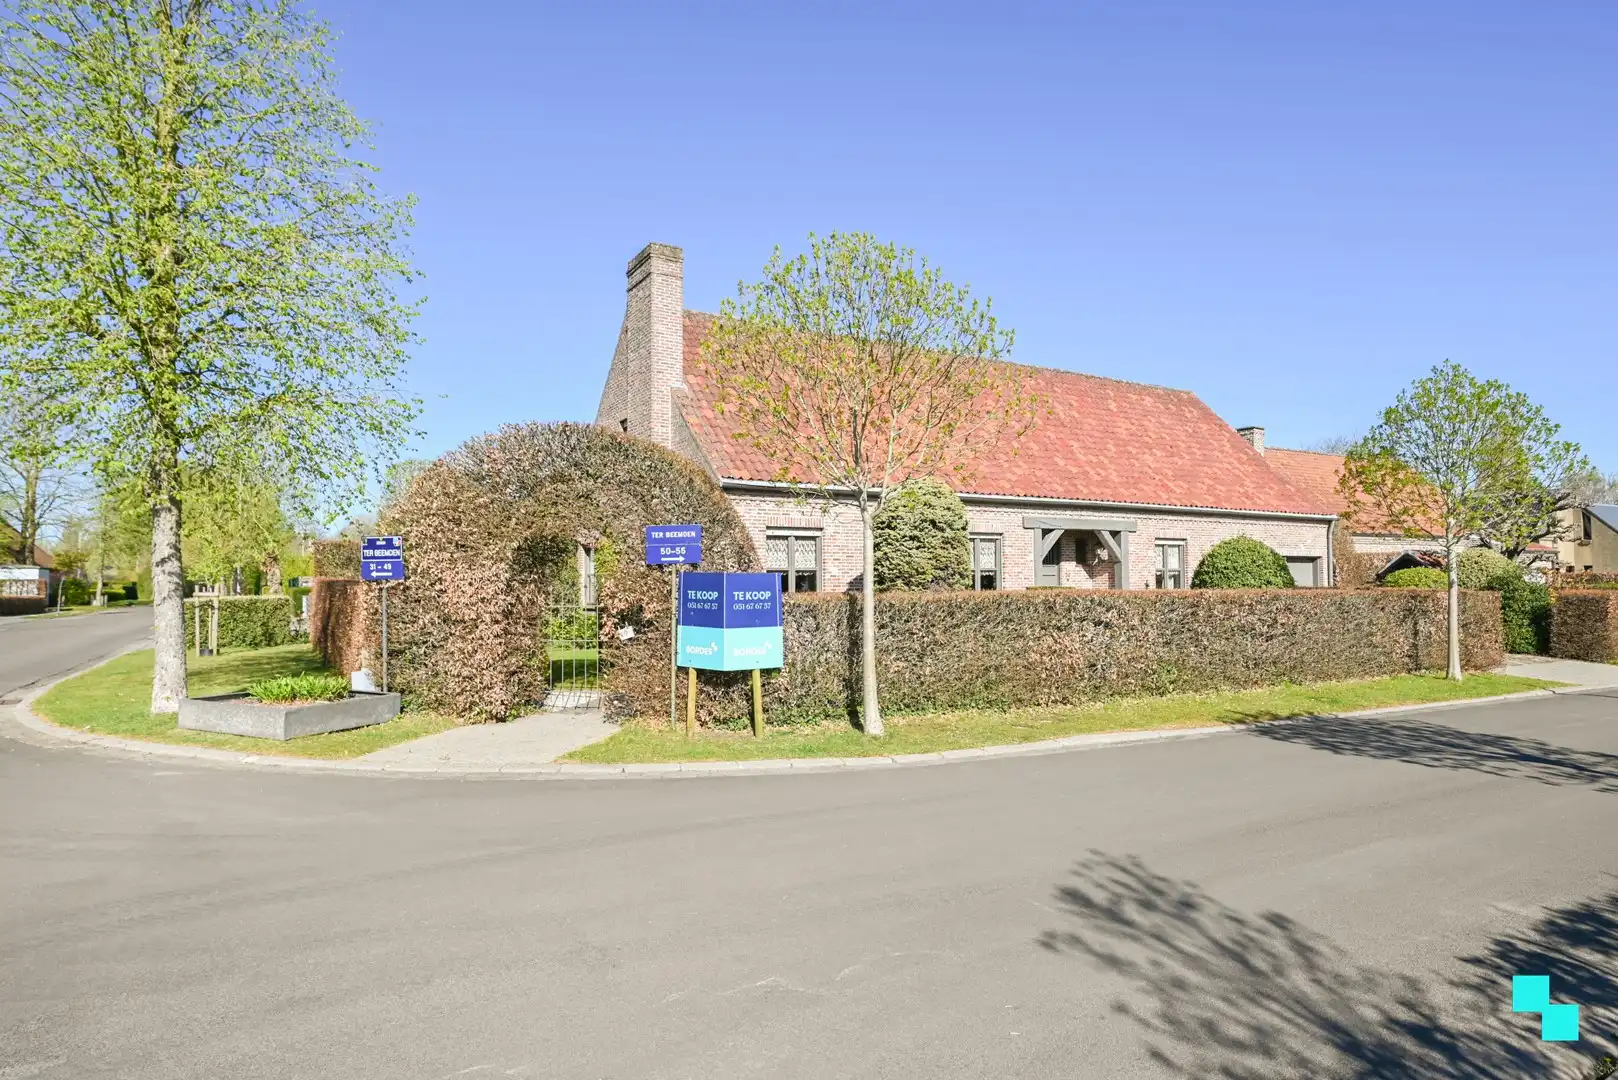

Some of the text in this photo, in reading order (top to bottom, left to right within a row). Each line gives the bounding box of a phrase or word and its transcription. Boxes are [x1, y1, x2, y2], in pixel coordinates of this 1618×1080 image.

[363, 549, 374, 557] TER
[687, 590, 719, 600] TE KOOP
[733, 591, 771, 600] TE KOOP
